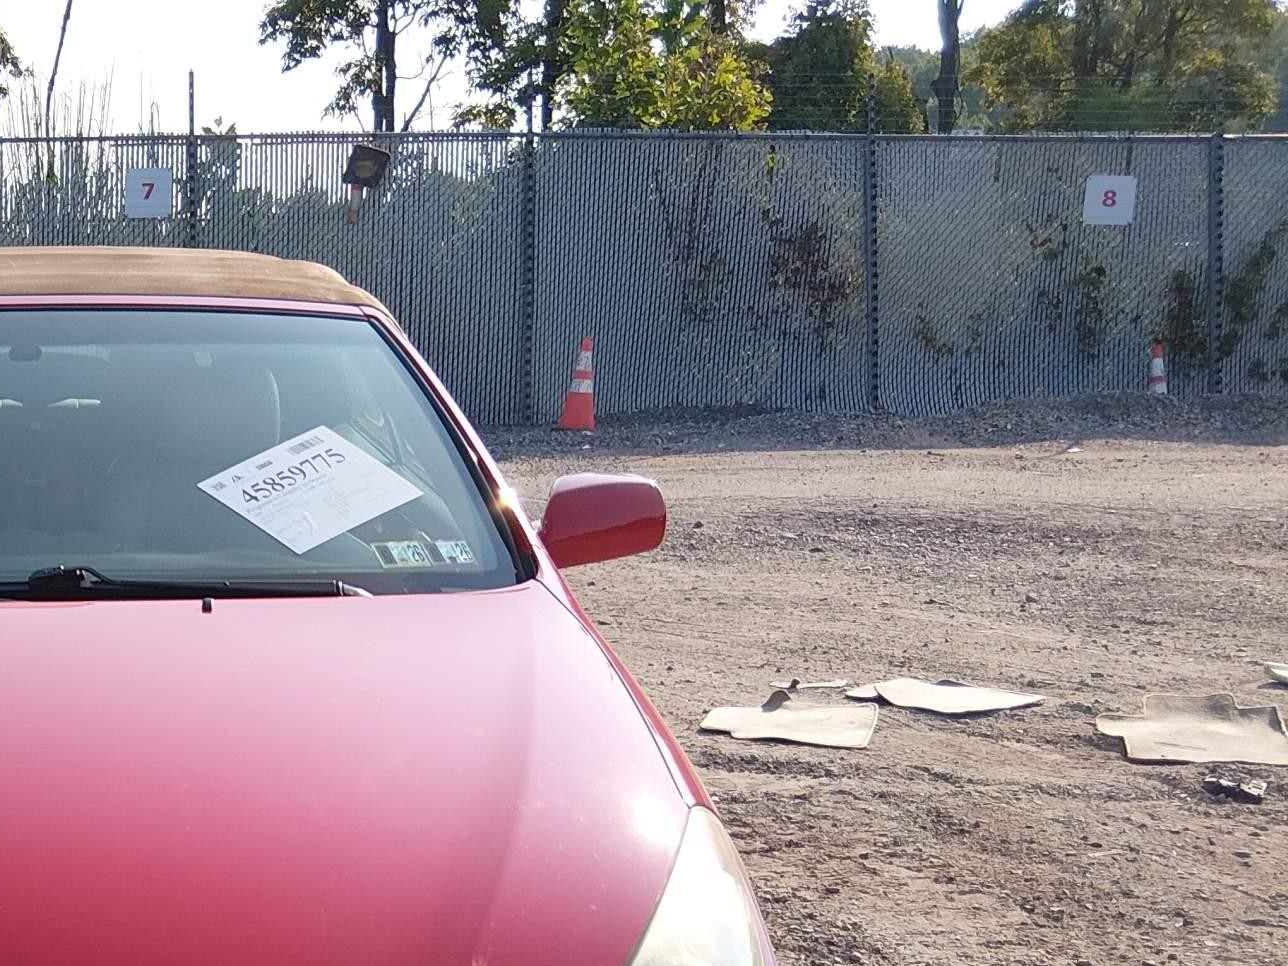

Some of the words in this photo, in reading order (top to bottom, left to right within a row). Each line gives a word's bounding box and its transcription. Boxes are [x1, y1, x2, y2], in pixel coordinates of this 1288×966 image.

[142, 182, 155, 200] 7
[1102, 190, 1117, 207] 8
[241, 448, 346, 504] 45859775
